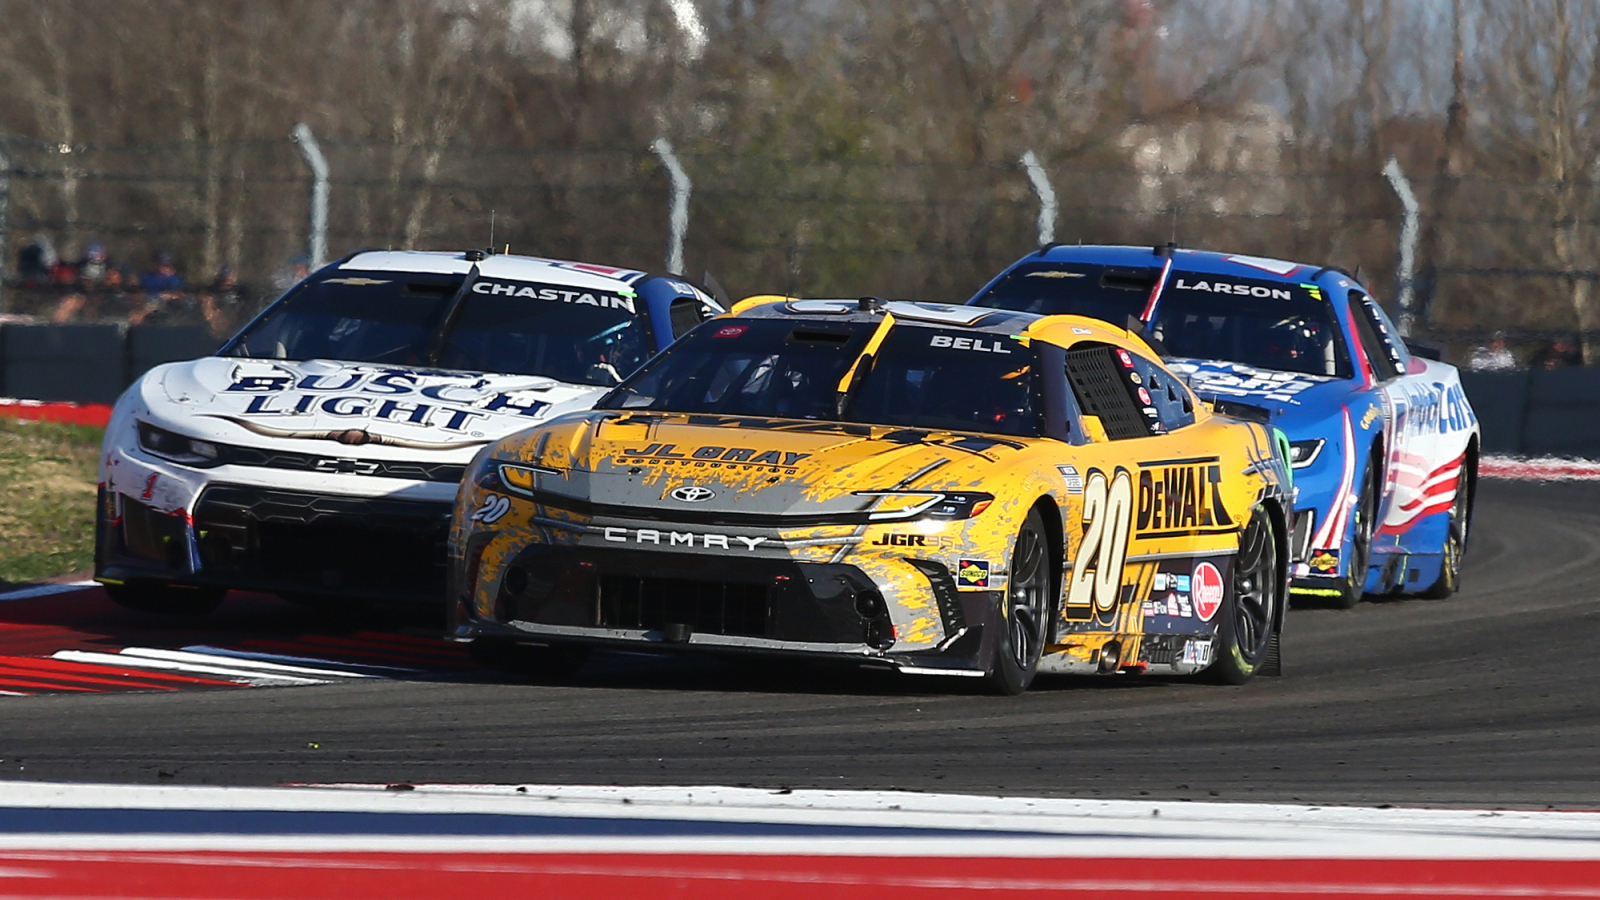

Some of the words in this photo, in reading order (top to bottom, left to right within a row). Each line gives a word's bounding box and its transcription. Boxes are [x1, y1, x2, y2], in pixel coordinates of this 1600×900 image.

[472, 282, 635, 314] CHASTAIN
[1176, 279, 1292, 300] LARSON
[930, 335, 1011, 354] BELL
[224, 366, 553, 418] BUSCH
[241, 395, 484, 432] LIGHT
[616, 458, 798, 475] CONSTRUCTION
[623, 443, 685, 458] JL
[691, 446, 813, 466] GRAY
[141, 472, 160, 501] 1
[470, 494, 511, 523] 20
[604, 526, 768, 551] CAMRY
[1066, 465, 1132, 620] 20
[960, 569, 988, 579] SUNOCO
